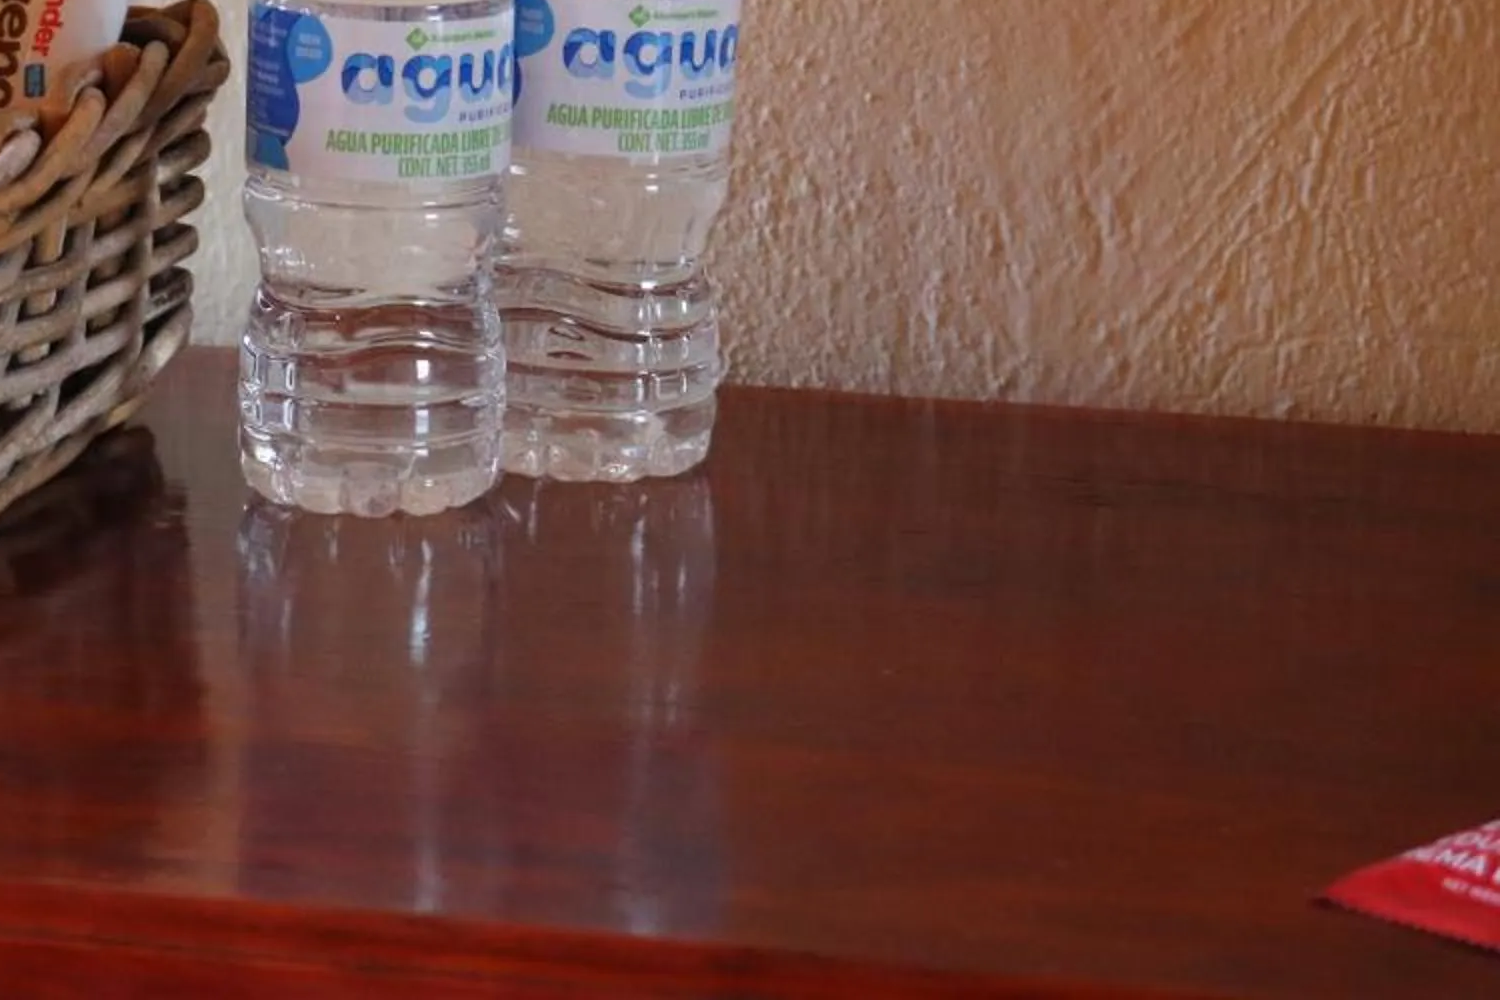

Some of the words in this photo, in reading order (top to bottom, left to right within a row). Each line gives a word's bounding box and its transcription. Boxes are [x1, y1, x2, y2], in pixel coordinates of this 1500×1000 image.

[547, 103, 589, 128] AGUA
[592, 106, 678, 130] PURIFICADA
[325, 128, 368, 153] AGUA
[370, 131, 459, 156] PURIFICADA
